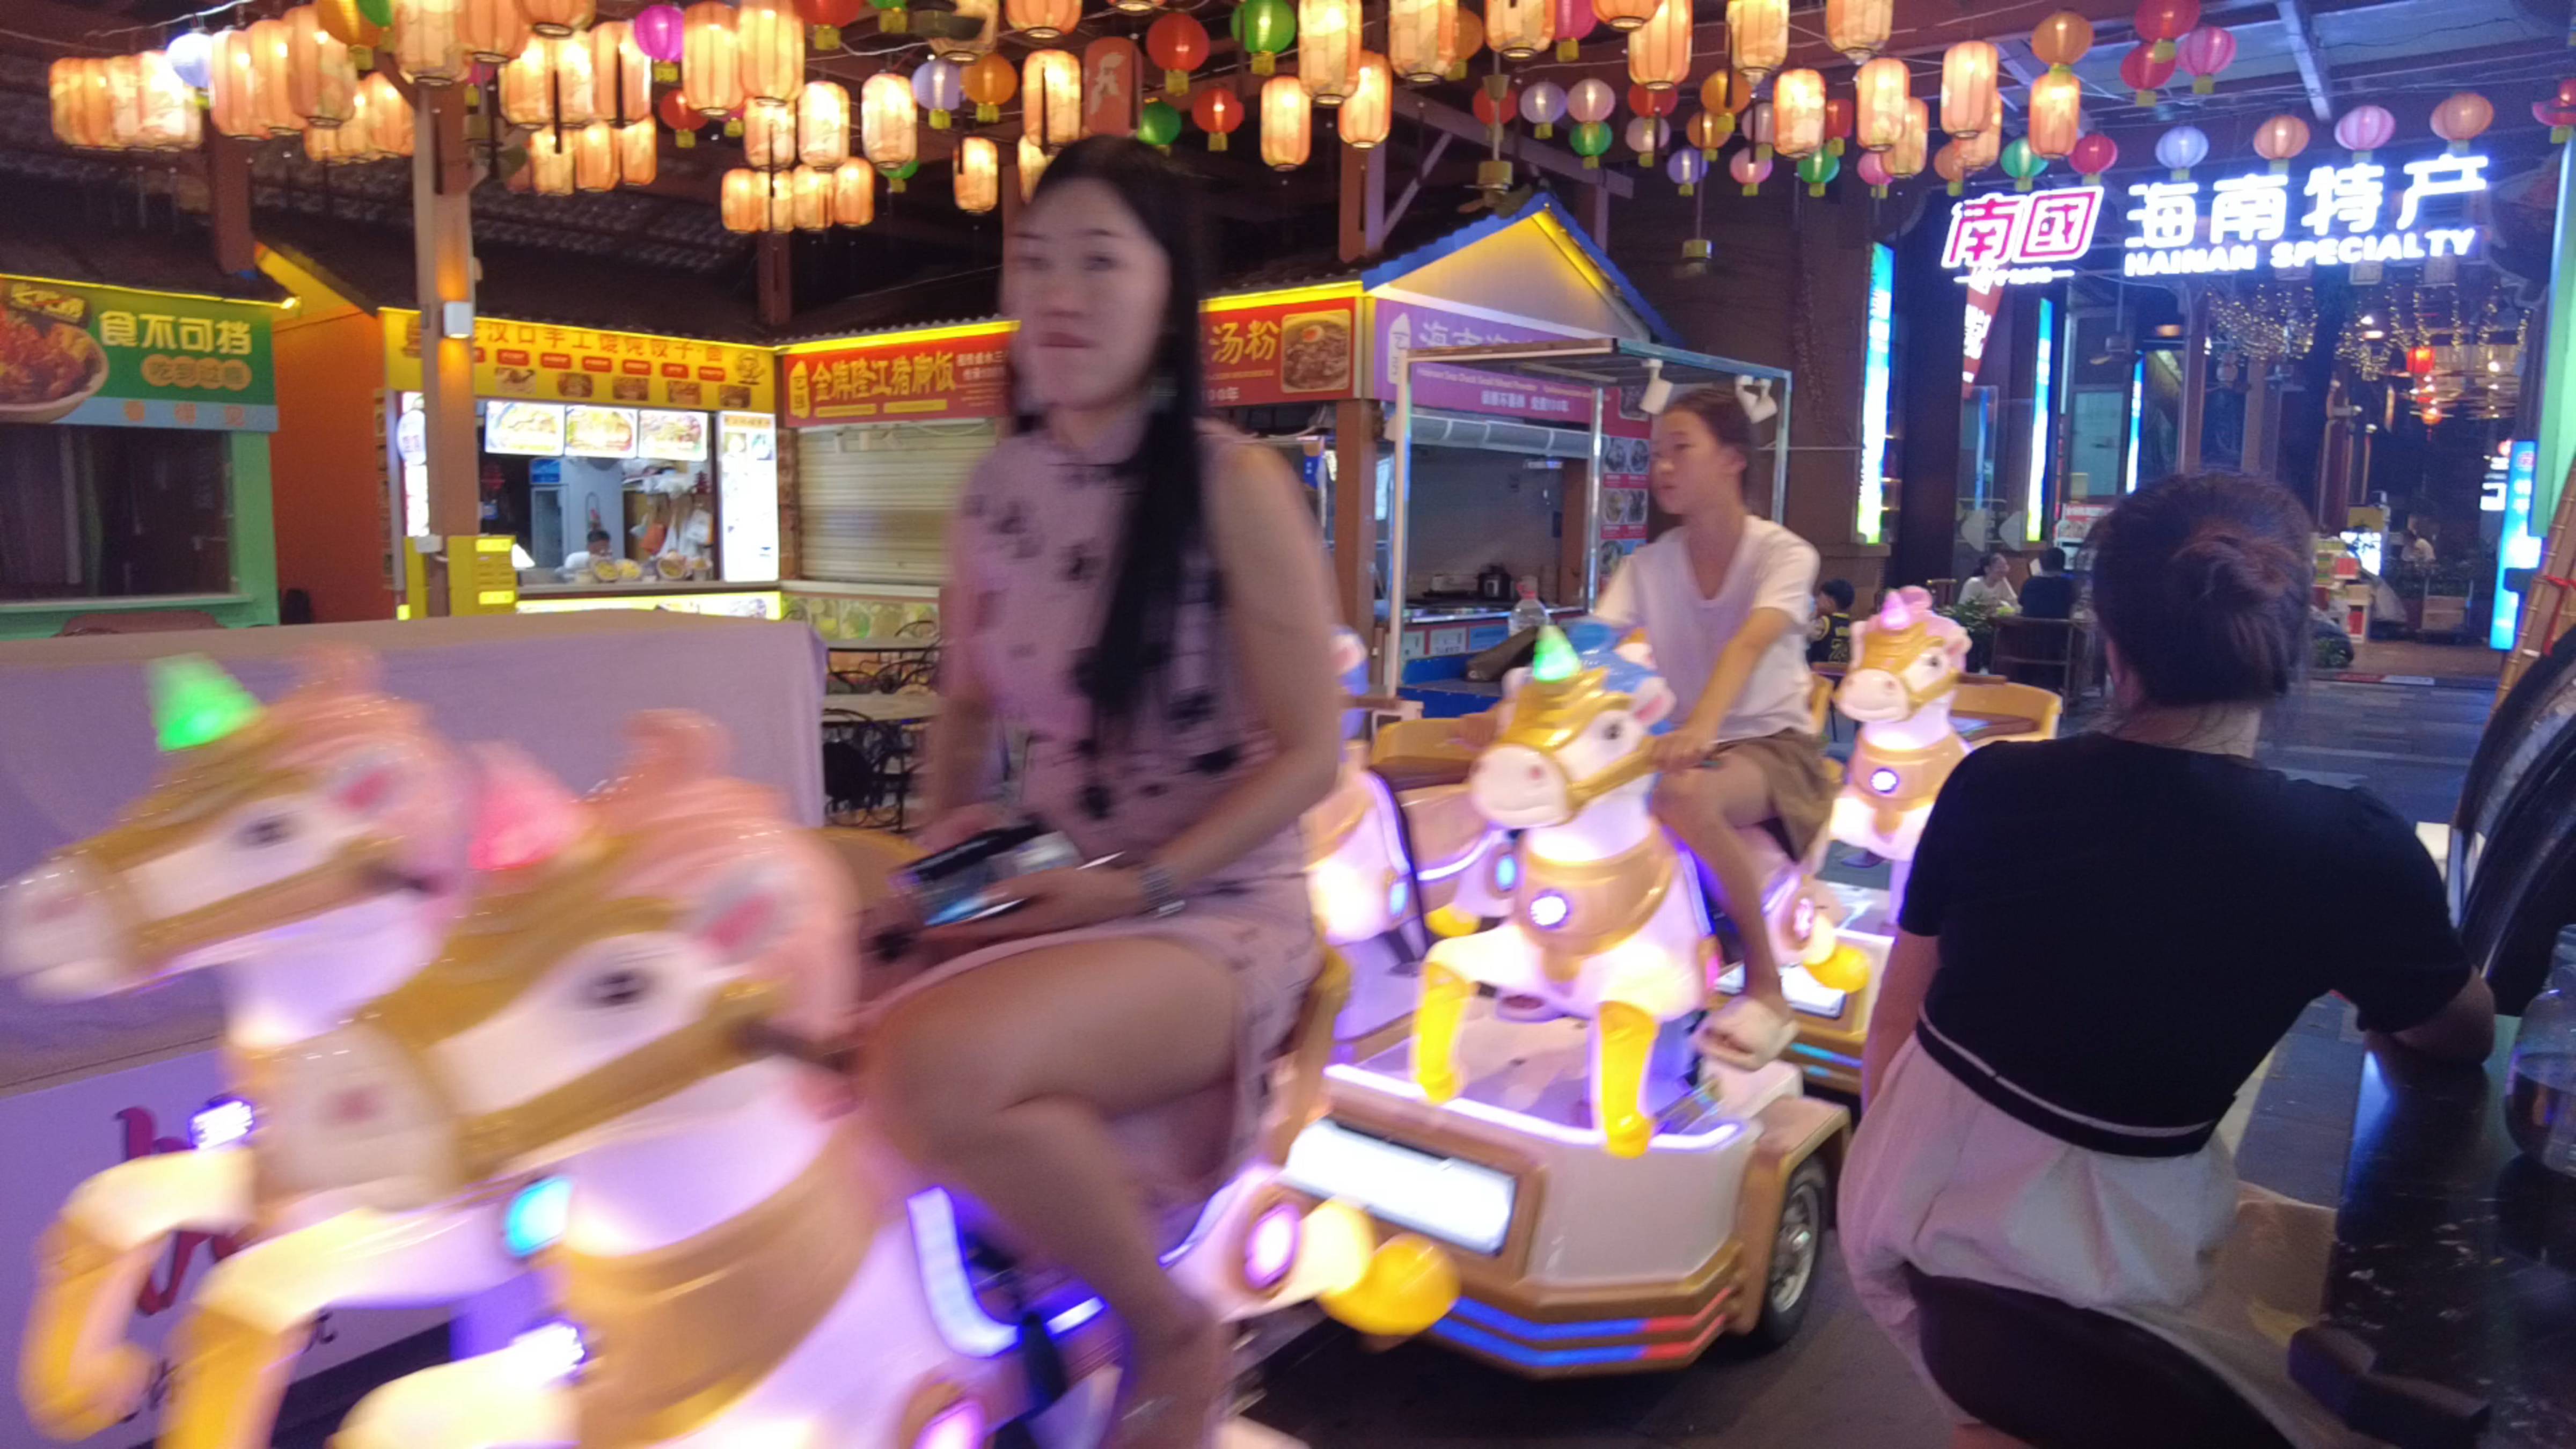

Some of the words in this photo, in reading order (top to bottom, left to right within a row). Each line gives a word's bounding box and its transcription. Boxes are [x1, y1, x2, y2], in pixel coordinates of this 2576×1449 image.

[2125, 153, 2489, 248] 海南特产
[2124, 245, 2257, 276] HAINAN
[2270, 228, 2476, 268] SPECIALTY
[99, 310, 252, 355] 食不可挡
[811, 350, 956, 402] 金牌隆江猪脚饭
